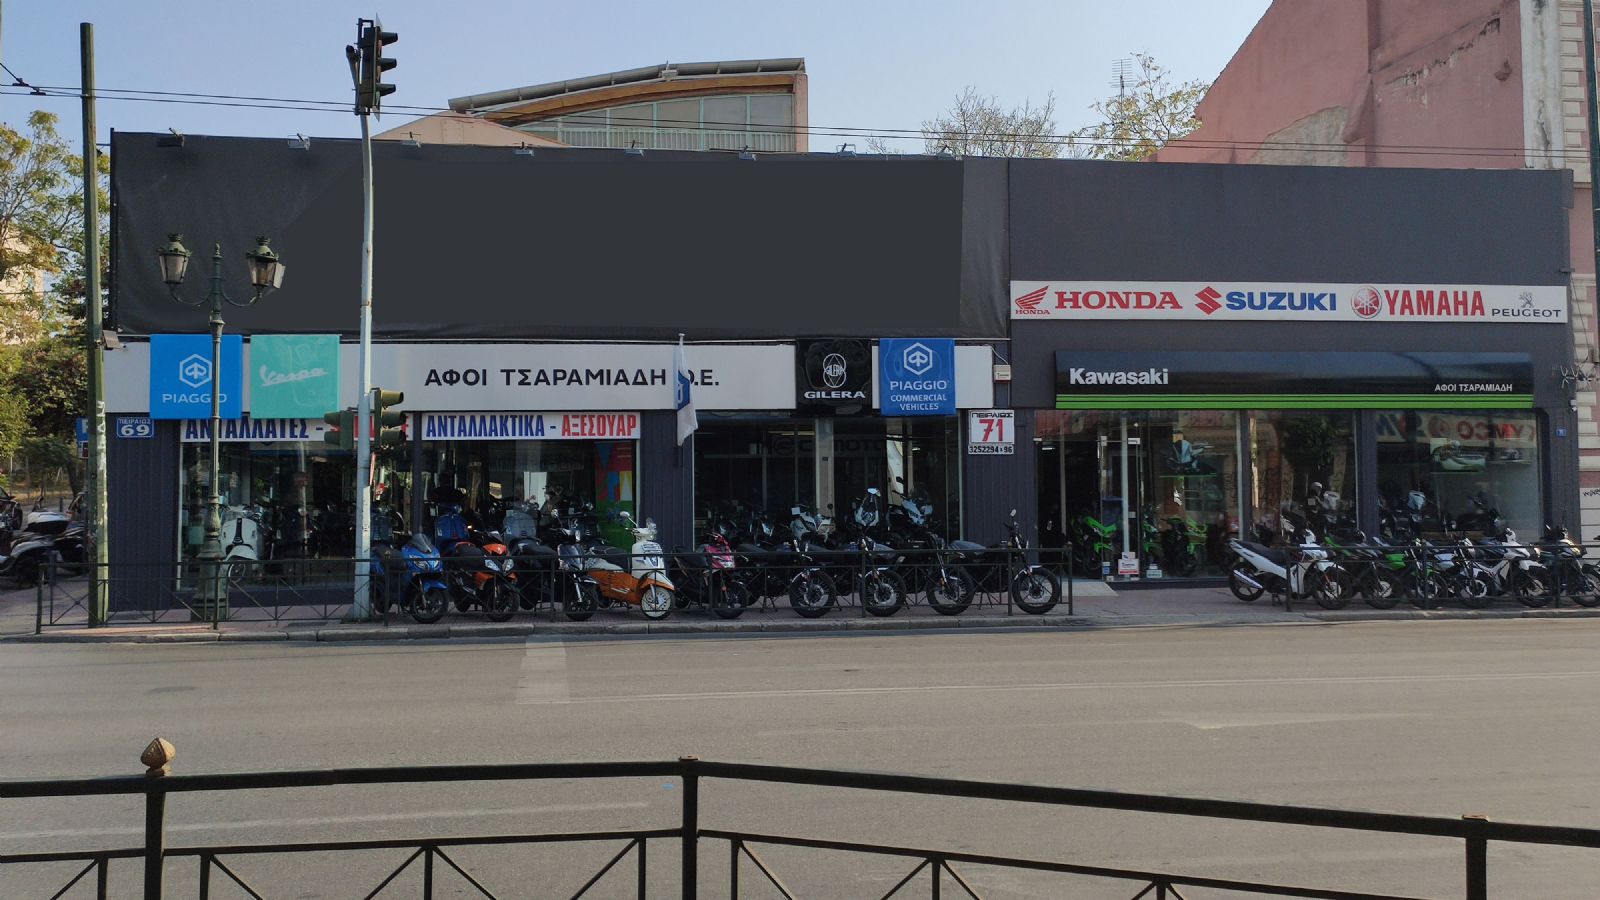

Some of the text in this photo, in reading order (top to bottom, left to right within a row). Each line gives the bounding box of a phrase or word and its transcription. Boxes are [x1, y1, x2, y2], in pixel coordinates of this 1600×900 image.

[1054, 291, 1183, 310] HONDA
[1225, 291, 1337, 311] SUZUKI
[1384, 290, 1485, 316] YAMAHA
[1491, 308, 1561, 318] PEUGEOT
[424, 368, 487, 386] ΑΦΟΙ
[500, 368, 666, 386] ΤΣΑΡΑΜΙΑΔΗ
[1069, 367, 1169, 385] Kawasaki
[890, 380, 947, 390] PIAGGIO
[1434, 383, 1513, 392] ΑΦΟΙ ΤΣΑΡΑΜΙΑΔΗ
[162, 393, 227, 404] PIAGGO
[804, 391, 866, 399] GILERA
[890, 394, 947, 402] COMMERCIAL
[121, 425, 150, 436] 69
[426, 415, 545, 437] ΑΝΤΑΛΛΑΚΤΙΚΑ
[561, 414, 636, 437] ΑΞΕΣΟΥΑΡ
[979, 419, 1003, 441] 71
